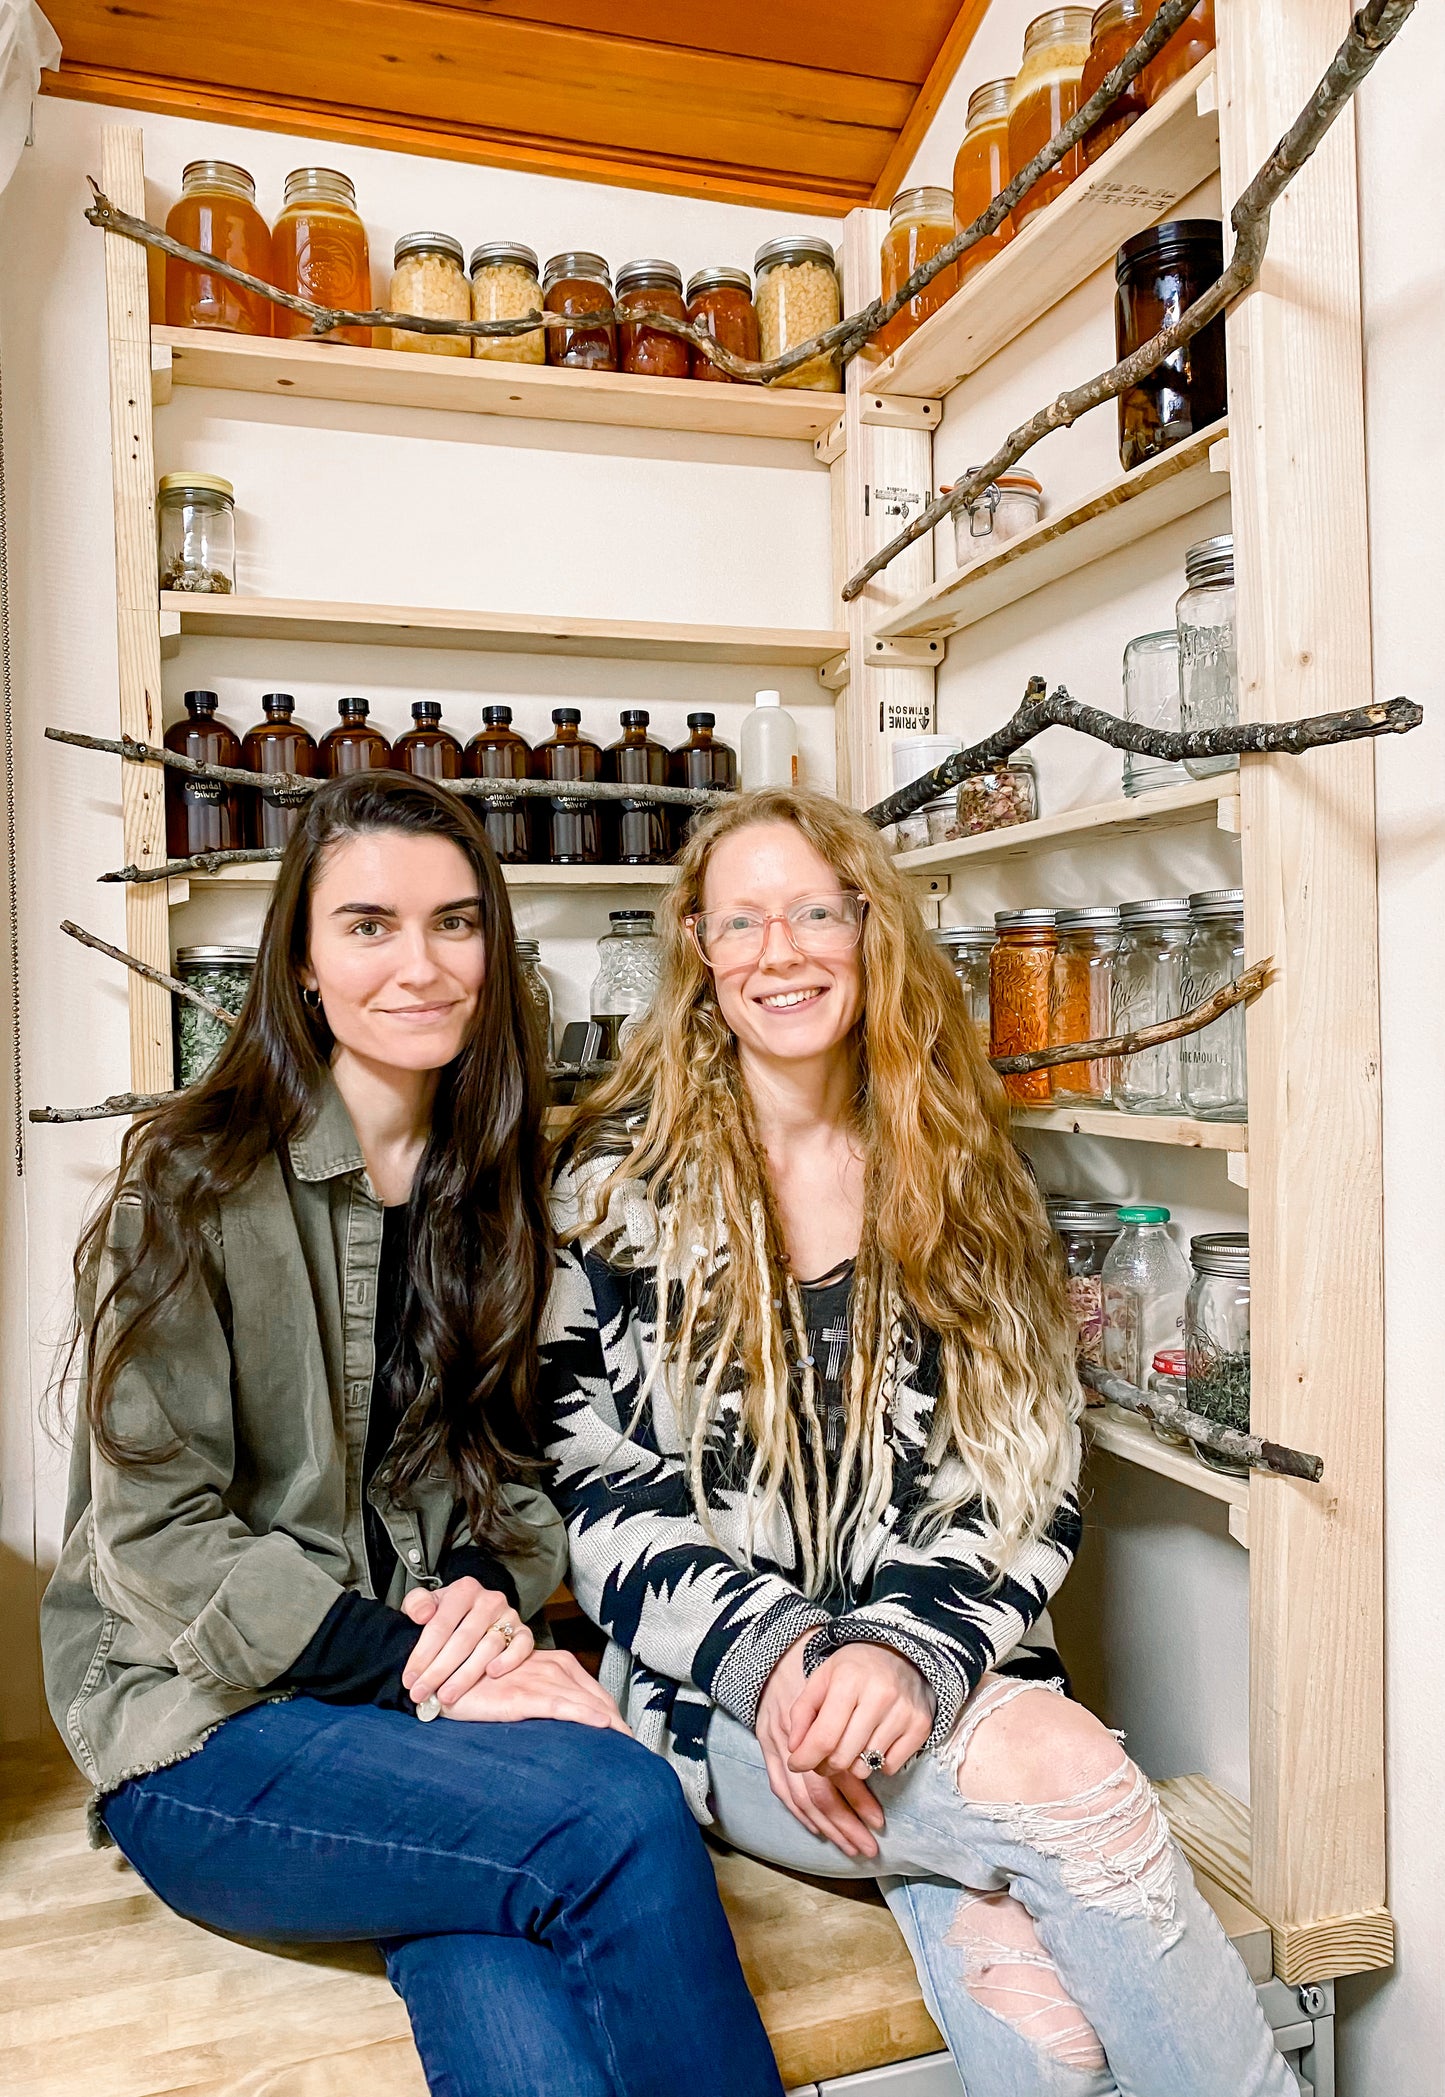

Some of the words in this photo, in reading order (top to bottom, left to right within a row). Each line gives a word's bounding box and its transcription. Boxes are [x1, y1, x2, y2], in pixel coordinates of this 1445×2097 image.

[888, 716, 917, 730] PRIME
[184, 780, 222, 792] Colloidal
[194, 791, 220, 799] Silver
[279, 796, 305, 804] Silver
